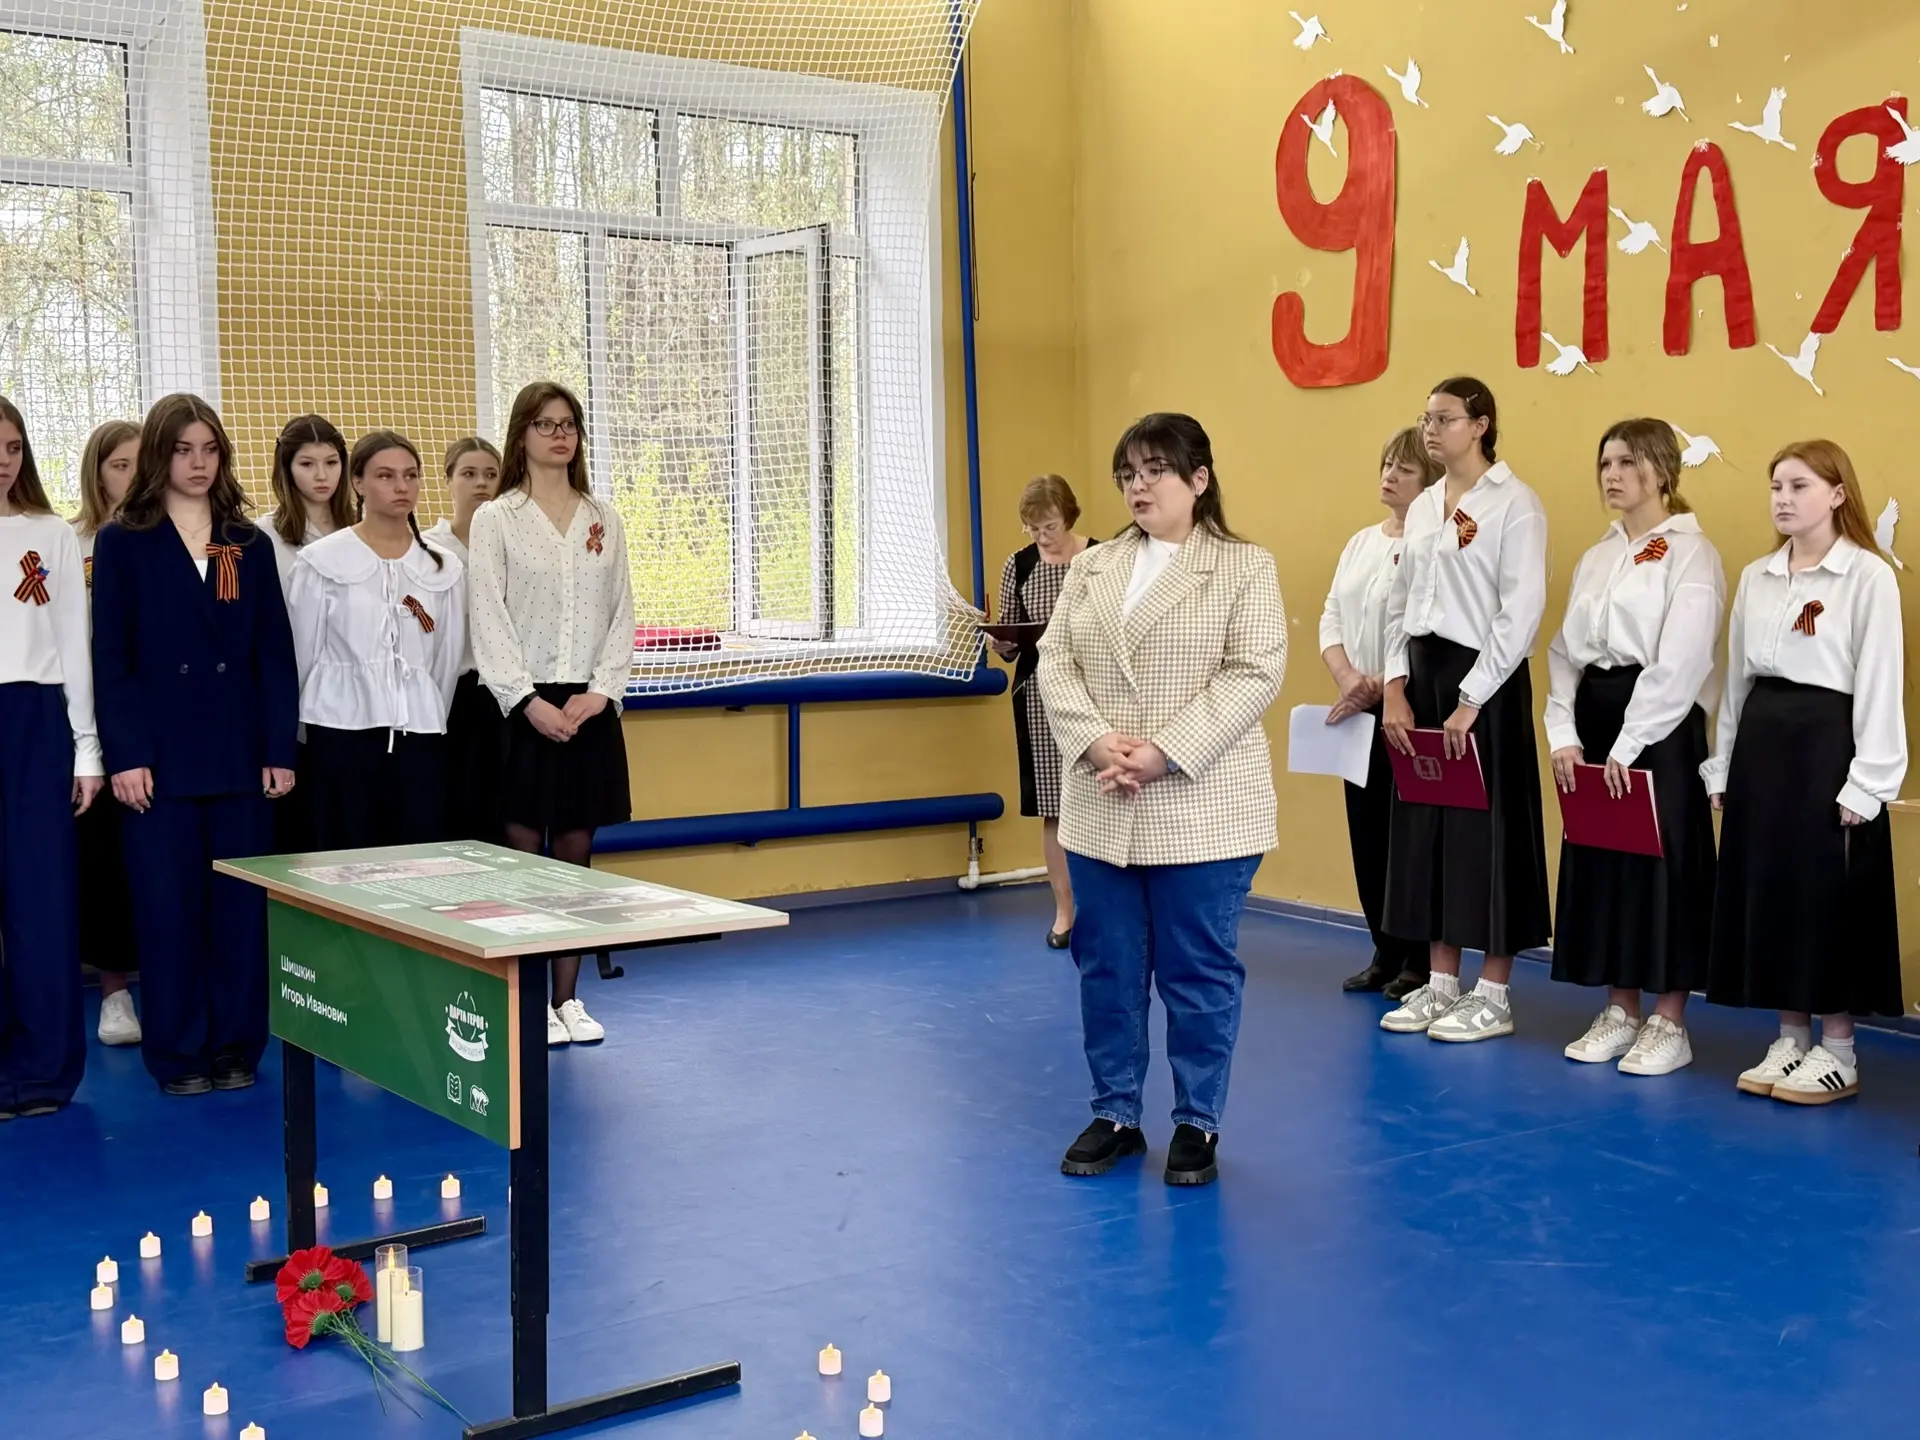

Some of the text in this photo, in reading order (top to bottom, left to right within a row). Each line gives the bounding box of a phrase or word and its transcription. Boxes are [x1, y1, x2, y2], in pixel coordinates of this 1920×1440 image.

[1272, 73, 1908, 389] 9 МАЯ
[280, 954, 316, 983] Шишкин
[281, 982, 348, 1026] Игорь Иванович
[449, 1003, 484, 1030] ПАРТА ГЕРОЯ
